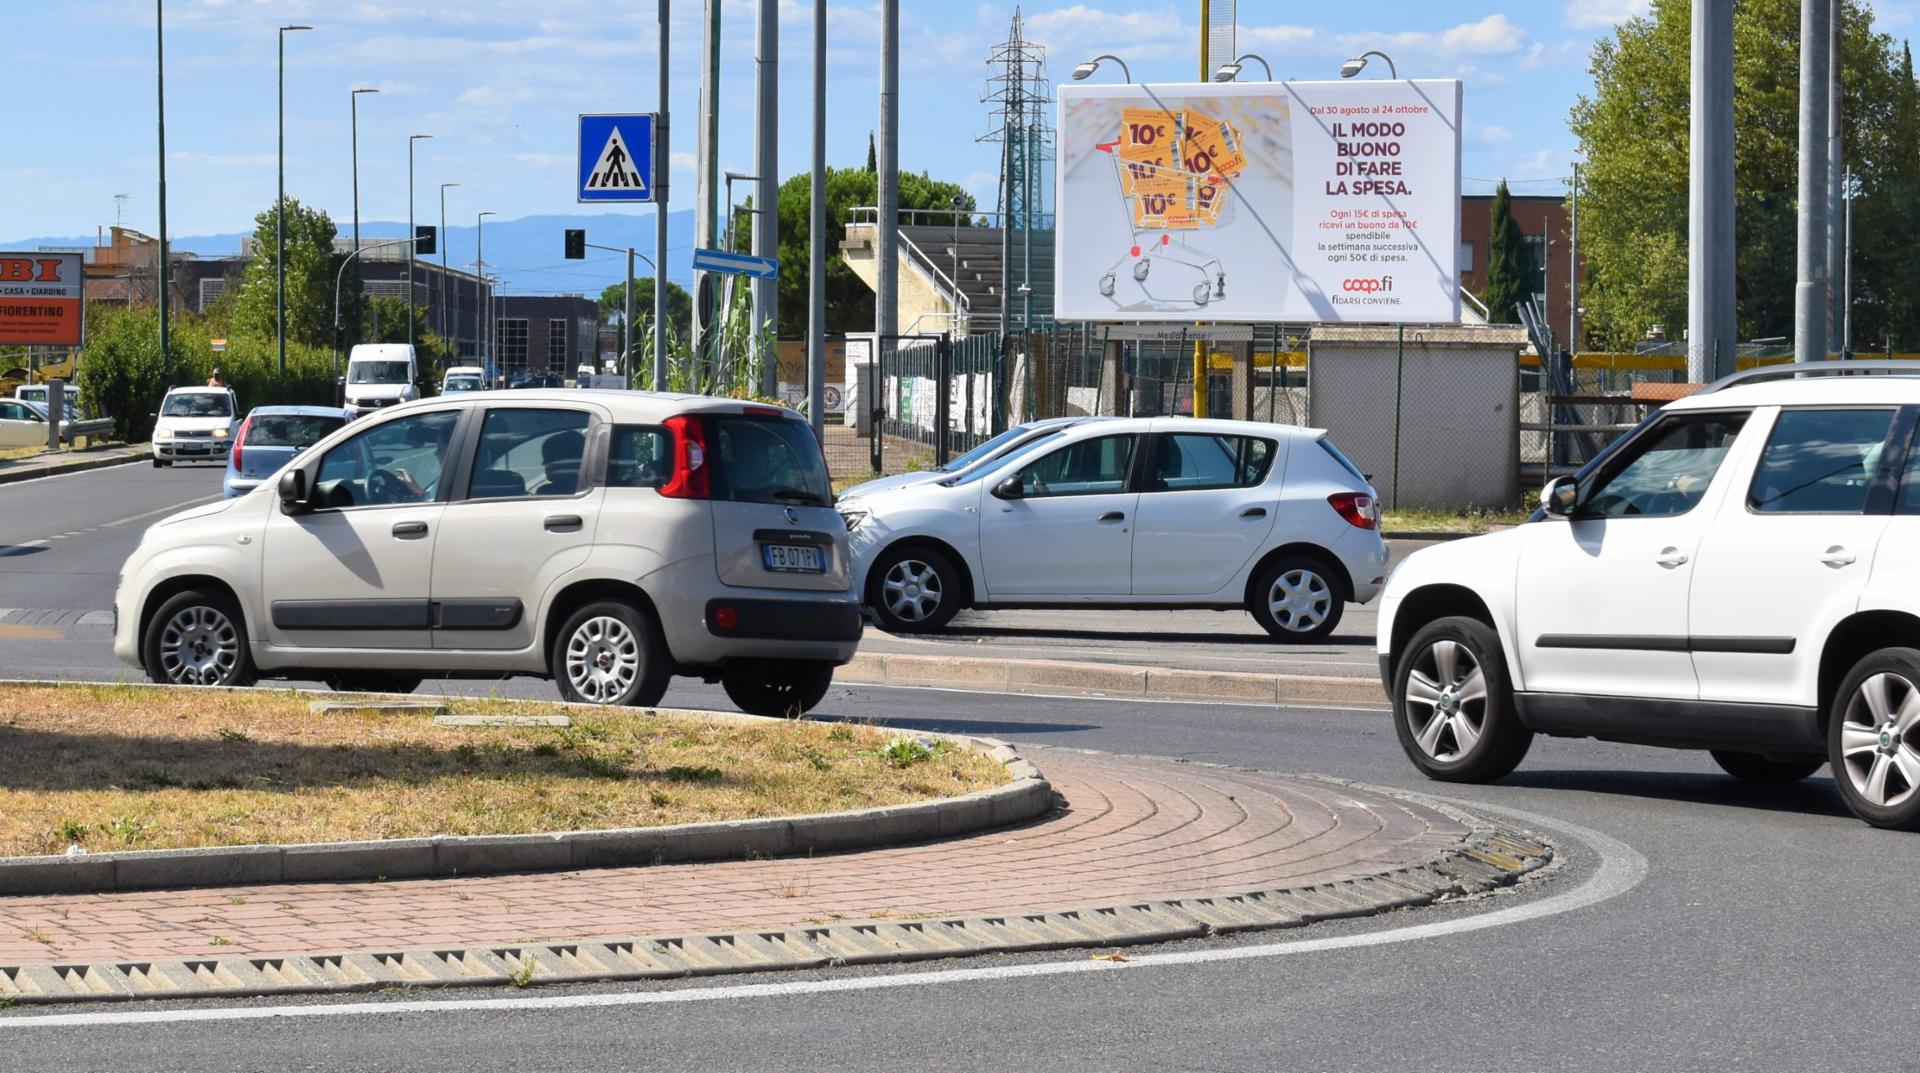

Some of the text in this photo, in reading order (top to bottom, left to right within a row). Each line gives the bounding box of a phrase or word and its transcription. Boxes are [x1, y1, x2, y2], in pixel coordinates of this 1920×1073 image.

[1311, 106, 1324, 115] Dal
[1327, 107, 1338, 115] 30
[1340, 107, 1370, 116] agosto
[1372, 106, 1380, 114] al
[1395, 105, 1428, 114] ottobre
[1129, 124, 1165, 145] 10€
[1333, 122, 1405, 137] IL MODO
[1337, 142, 1401, 157] BUONO
[1336, 162, 1402, 176] DI FARE
[1326, 181, 1412, 195] LA SPESA.
[1330, 210, 1407, 220] Ogni 15€ di spesa
[1319, 221, 1343, 229] ricevi
[1358, 221, 1386, 229] buono
[1388, 221, 1399, 229] da
[1346, 232, 1391, 241] spendibile
[1318, 243, 1418, 251] la settimana successiva
[1328, 254, 1408, 263] ogni 50€ di spesa.
[1343, 276, 1392, 294] coop.fi
[4, 287, 67, 296] CASA GIARDINO
[771, 547, 785, 566] FB
